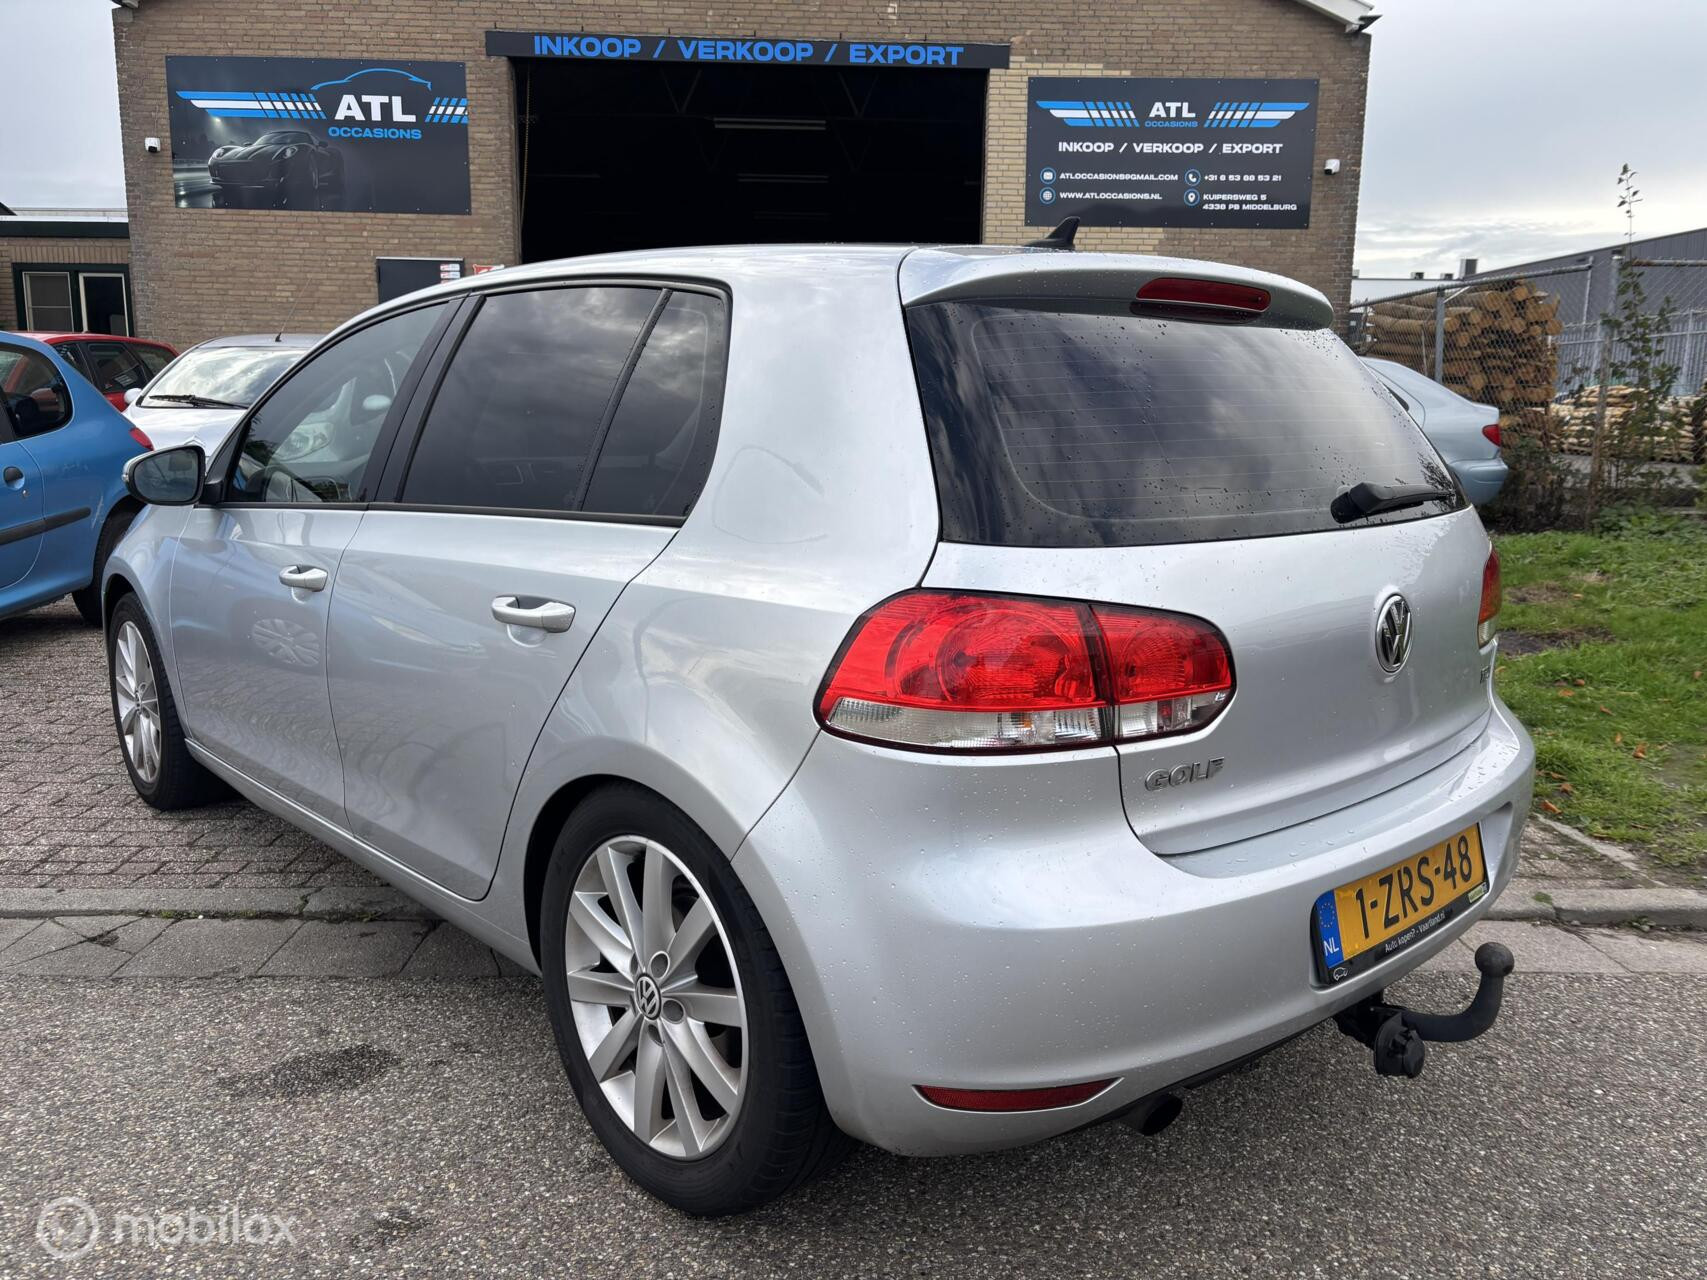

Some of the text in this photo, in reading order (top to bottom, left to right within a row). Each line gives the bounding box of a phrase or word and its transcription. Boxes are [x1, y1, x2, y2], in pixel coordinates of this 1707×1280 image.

[534, 35, 965, 65] INKOOP / VERKOOP / EXPORT
[334, 94, 417, 123] ATL
[1149, 102, 1196, 118] ATL
[1144, 120, 1199, 128] OCCASIONS
[328, 126, 422, 140] OCCASIONS
[1058, 141, 1114, 153] INKOOP
[1133, 142, 1204, 153] VERKOOP
[1222, 143, 1283, 154] EXPORT
[1204, 174, 1218, 182] +31
[1059, 191, 1162, 200] WWW.ATLOCCASIONS.NL
[1202, 193, 1258, 201] KUIPERSWEG
[1242, 203, 1298, 211] MIDDELBURG
[1144, 757, 1224, 791] GOLF
[1355, 835, 1472, 940] 1-ZRS-48
[1323, 937, 1340, 956] NL
